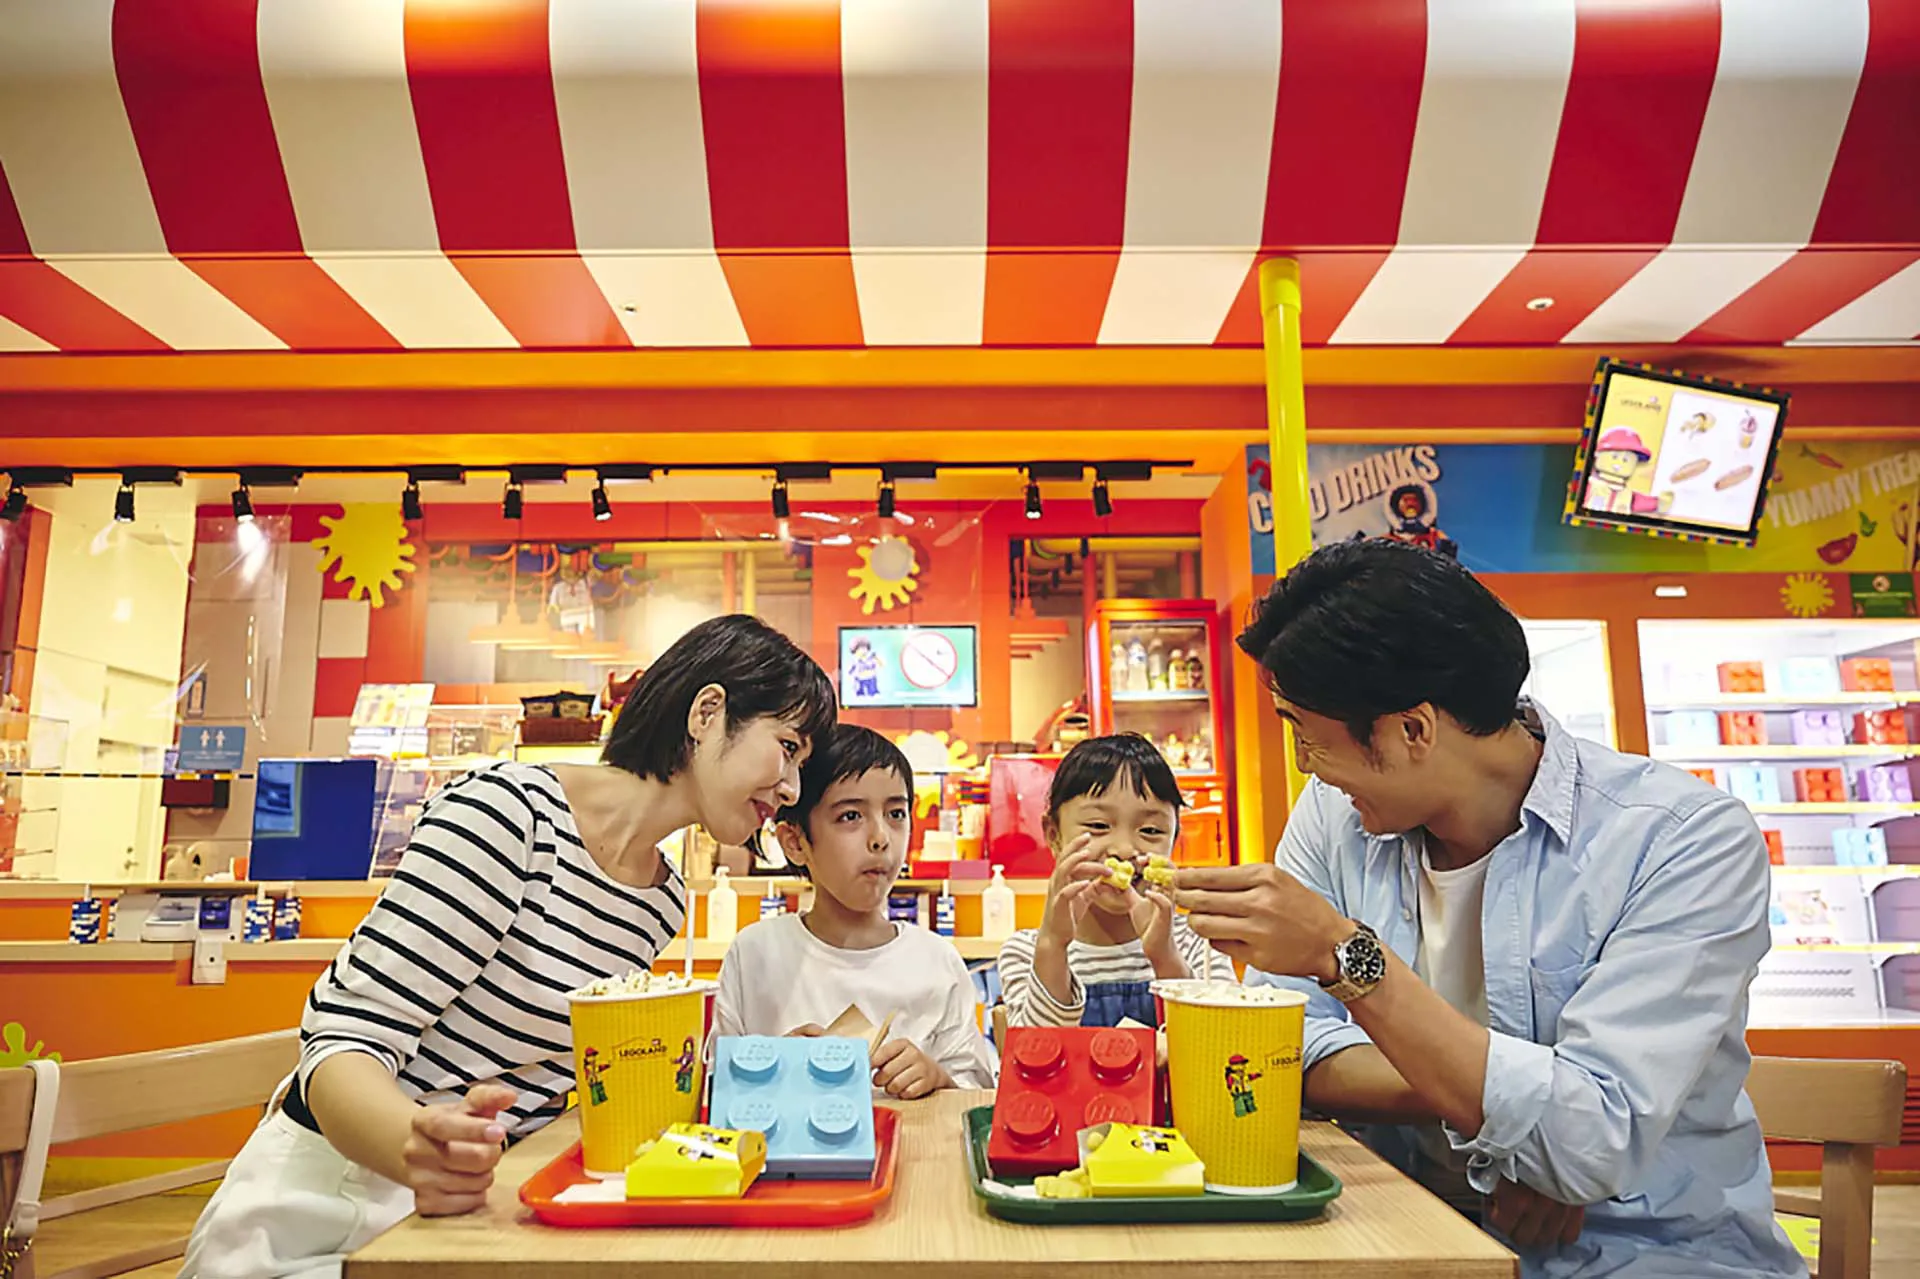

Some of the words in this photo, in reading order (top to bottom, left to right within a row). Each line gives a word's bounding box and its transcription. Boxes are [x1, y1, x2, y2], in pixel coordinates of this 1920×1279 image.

[1249, 479, 1328, 533] CD
[1329, 445, 1441, 513] DRINKS
[1766, 469, 1863, 528] YUMMY
